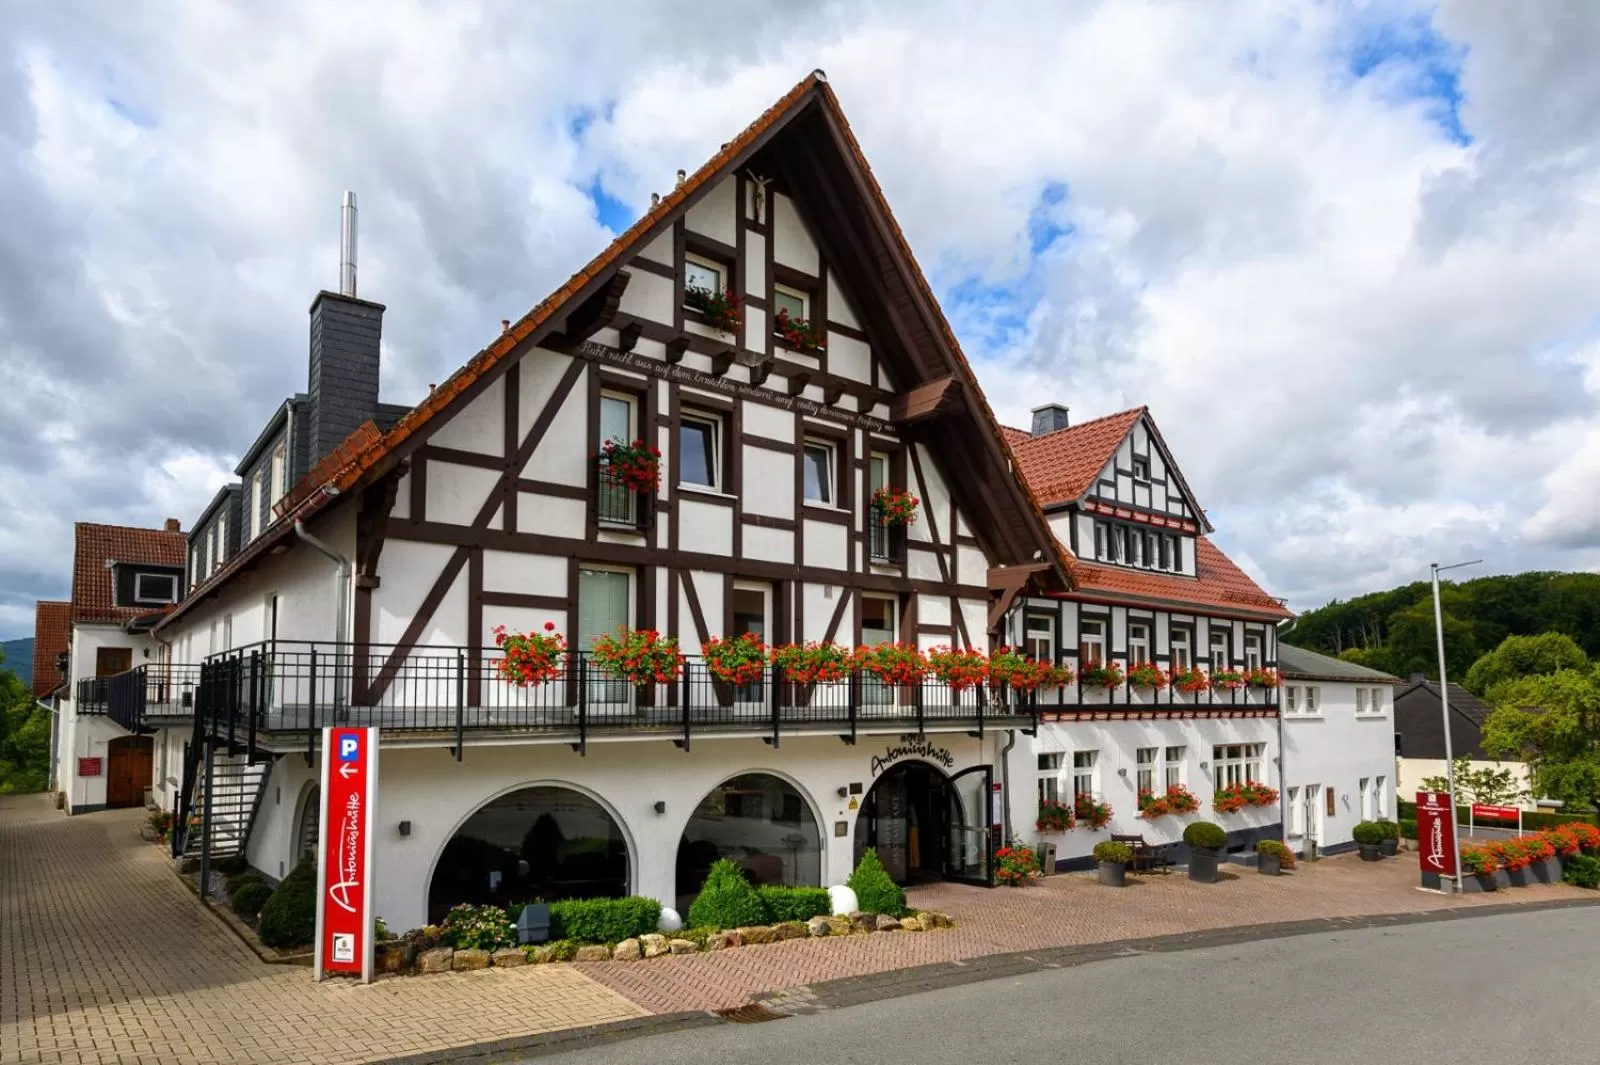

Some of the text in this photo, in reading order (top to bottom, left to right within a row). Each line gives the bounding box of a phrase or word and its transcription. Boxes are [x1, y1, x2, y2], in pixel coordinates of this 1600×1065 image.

[655, 364, 670, 379] auf
[342, 738, 357, 757] P
[329, 791, 360, 912] Antoniushütte
